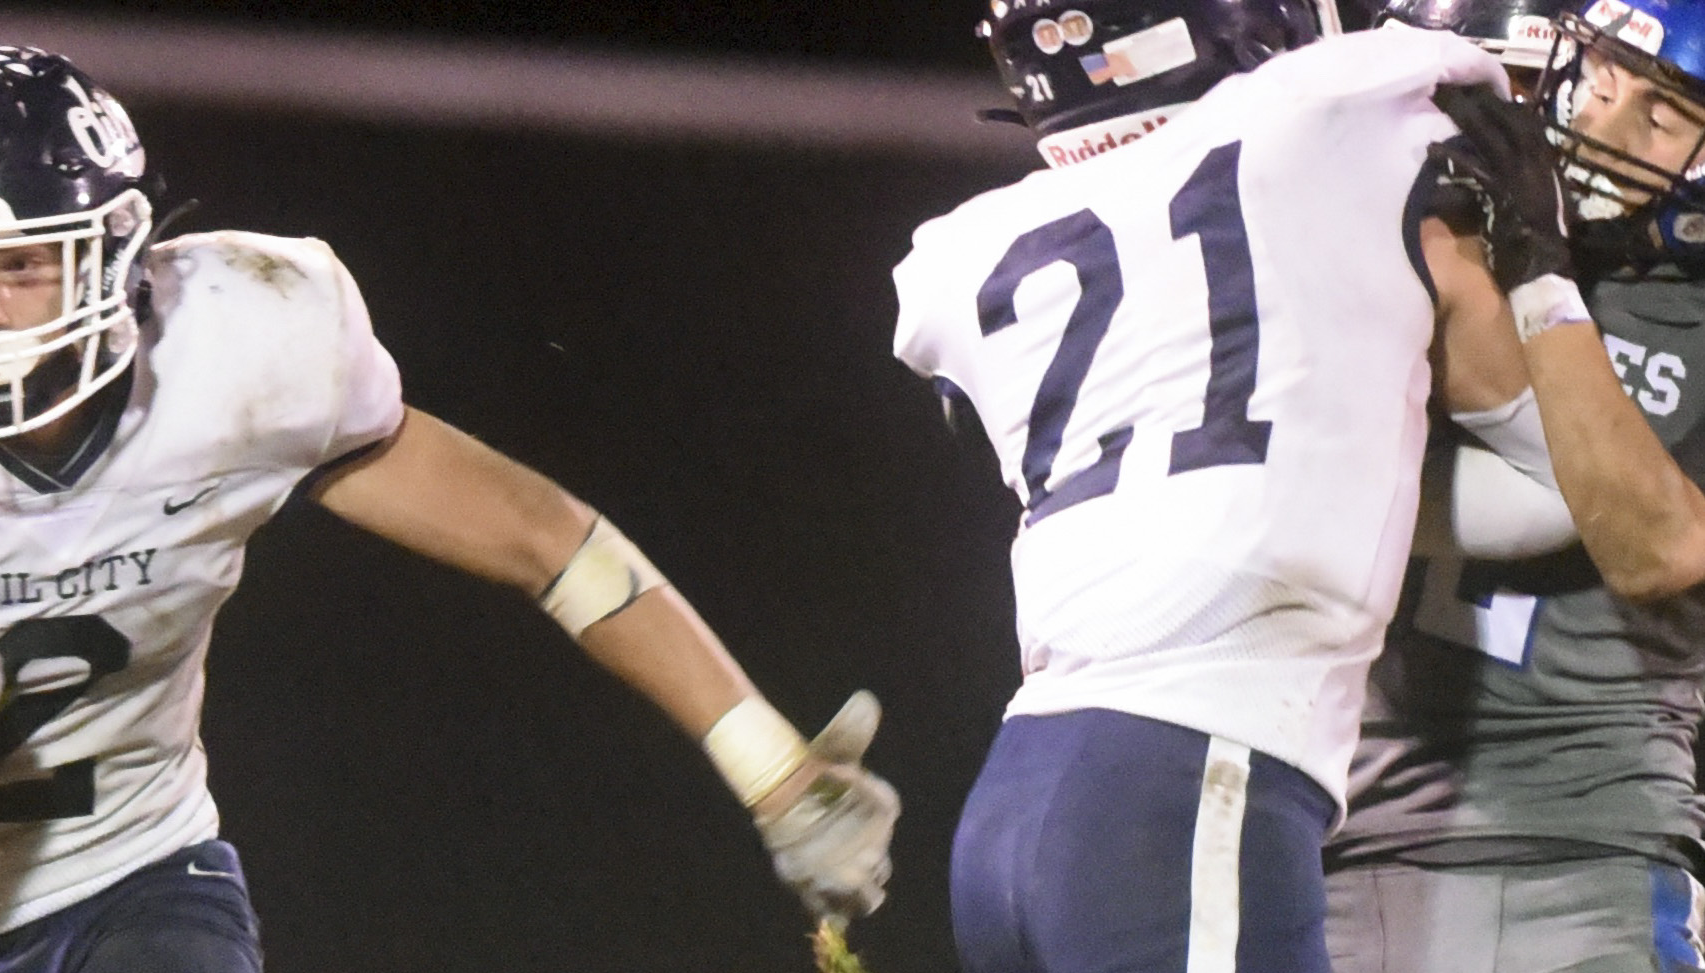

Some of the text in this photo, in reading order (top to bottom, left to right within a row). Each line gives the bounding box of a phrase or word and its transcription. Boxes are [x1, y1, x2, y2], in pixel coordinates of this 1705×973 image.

[1025, 73, 1054, 101] 21
[976, 139, 1273, 529] 21
[56, 548, 157, 600] CITY
